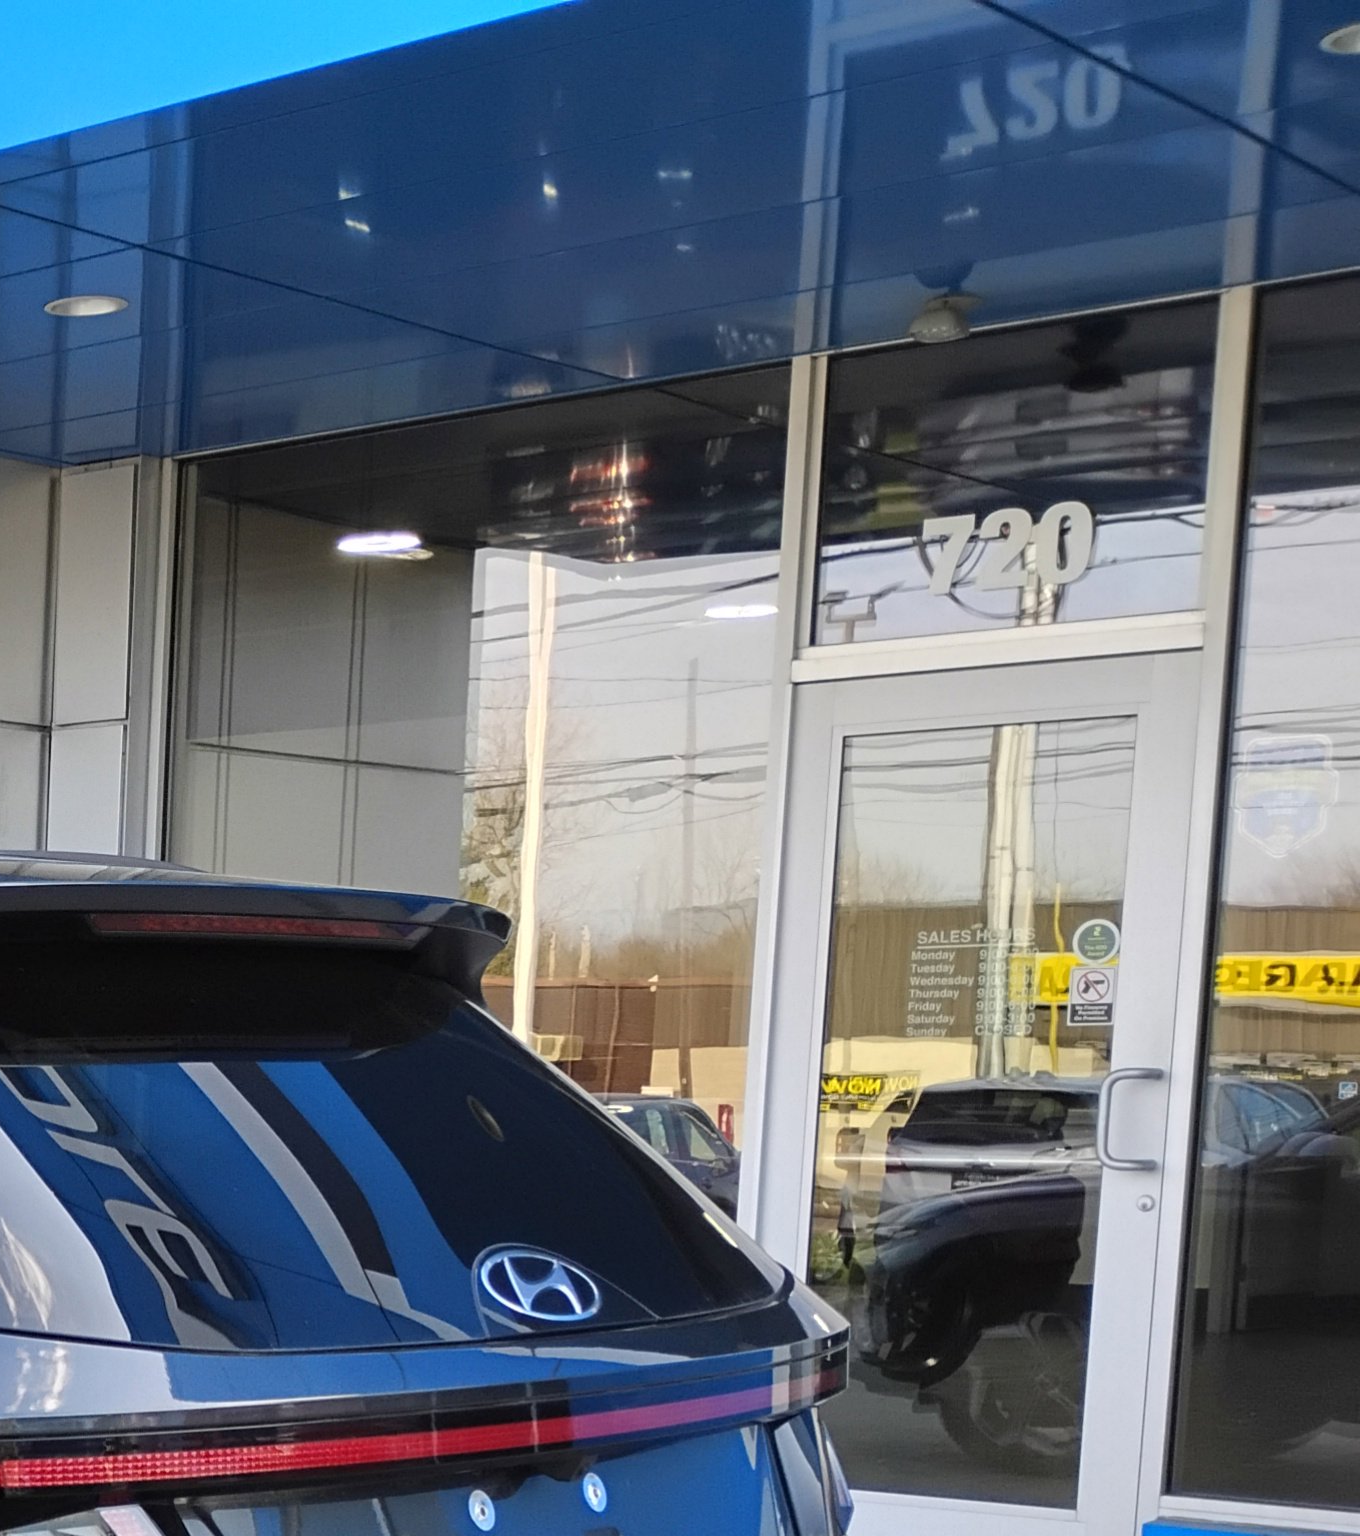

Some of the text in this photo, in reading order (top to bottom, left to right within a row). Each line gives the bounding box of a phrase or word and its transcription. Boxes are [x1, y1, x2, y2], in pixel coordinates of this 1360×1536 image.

[922, 500, 1096, 597] 720
[917, 929, 972, 945] SALES
[910, 950, 956, 963] Monday
[910, 962, 956, 975] Tuesday
[909, 974, 975, 987] Wednesday
[908, 988, 960, 1000] Thursday
[907, 1000, 942, 1013] Friday
[906, 1013, 956, 1026] Saturday
[906, 1024, 1033, 1039] Sunday CLOSED
